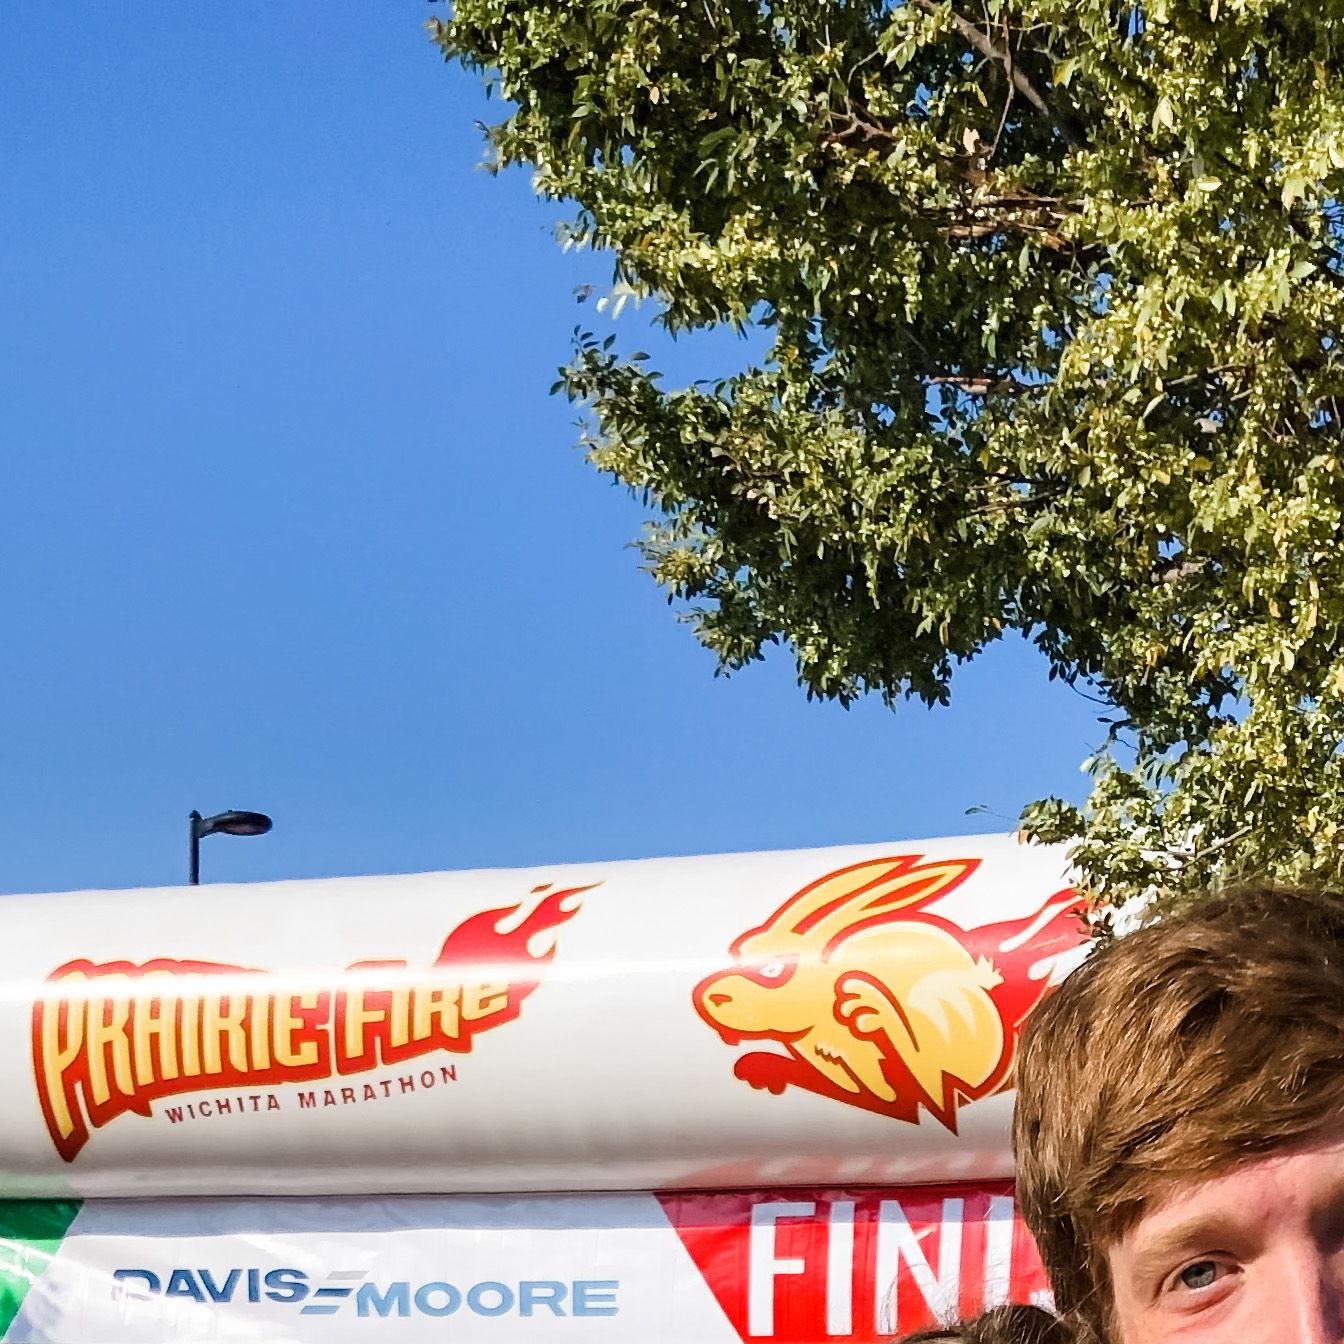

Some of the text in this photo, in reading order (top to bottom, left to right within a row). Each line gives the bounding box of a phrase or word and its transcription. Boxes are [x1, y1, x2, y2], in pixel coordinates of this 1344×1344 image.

[35, 960, 328, 1158] PRAIRIE
[164, 1063, 459, 1124] WICHITA MARATHON
[748, 1195, 1056, 1337] FINI
